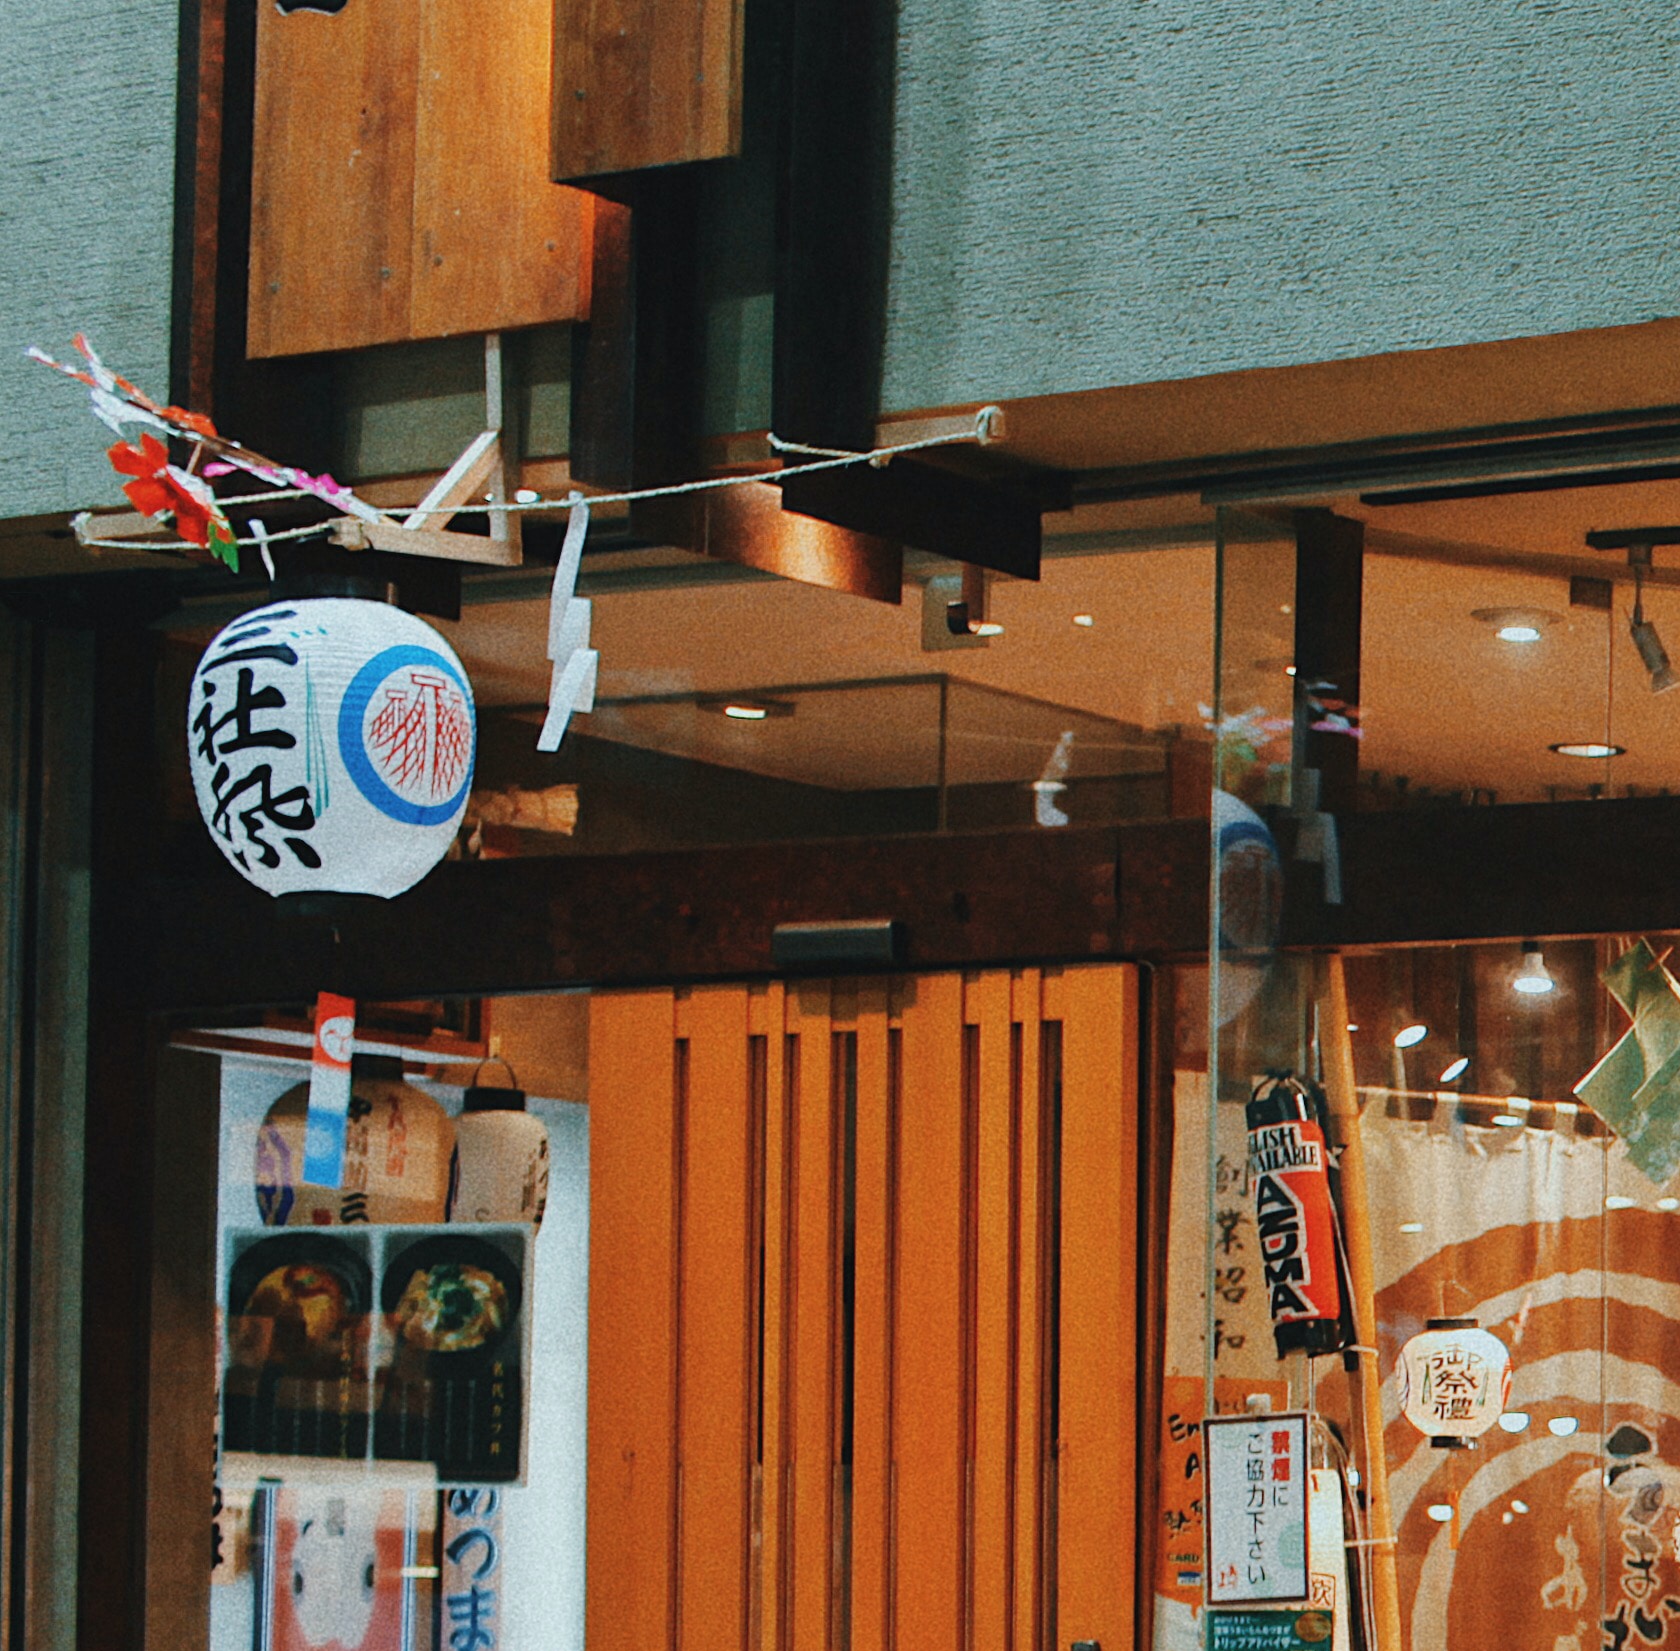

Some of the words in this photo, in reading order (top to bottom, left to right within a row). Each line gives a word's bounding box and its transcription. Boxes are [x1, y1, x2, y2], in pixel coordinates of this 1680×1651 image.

[193, 610, 323, 873] 三社祭
[1247, 1433, 1266, 1585] ご協力下さい
[1271, 1430, 1290, 1506] 禁煙に
